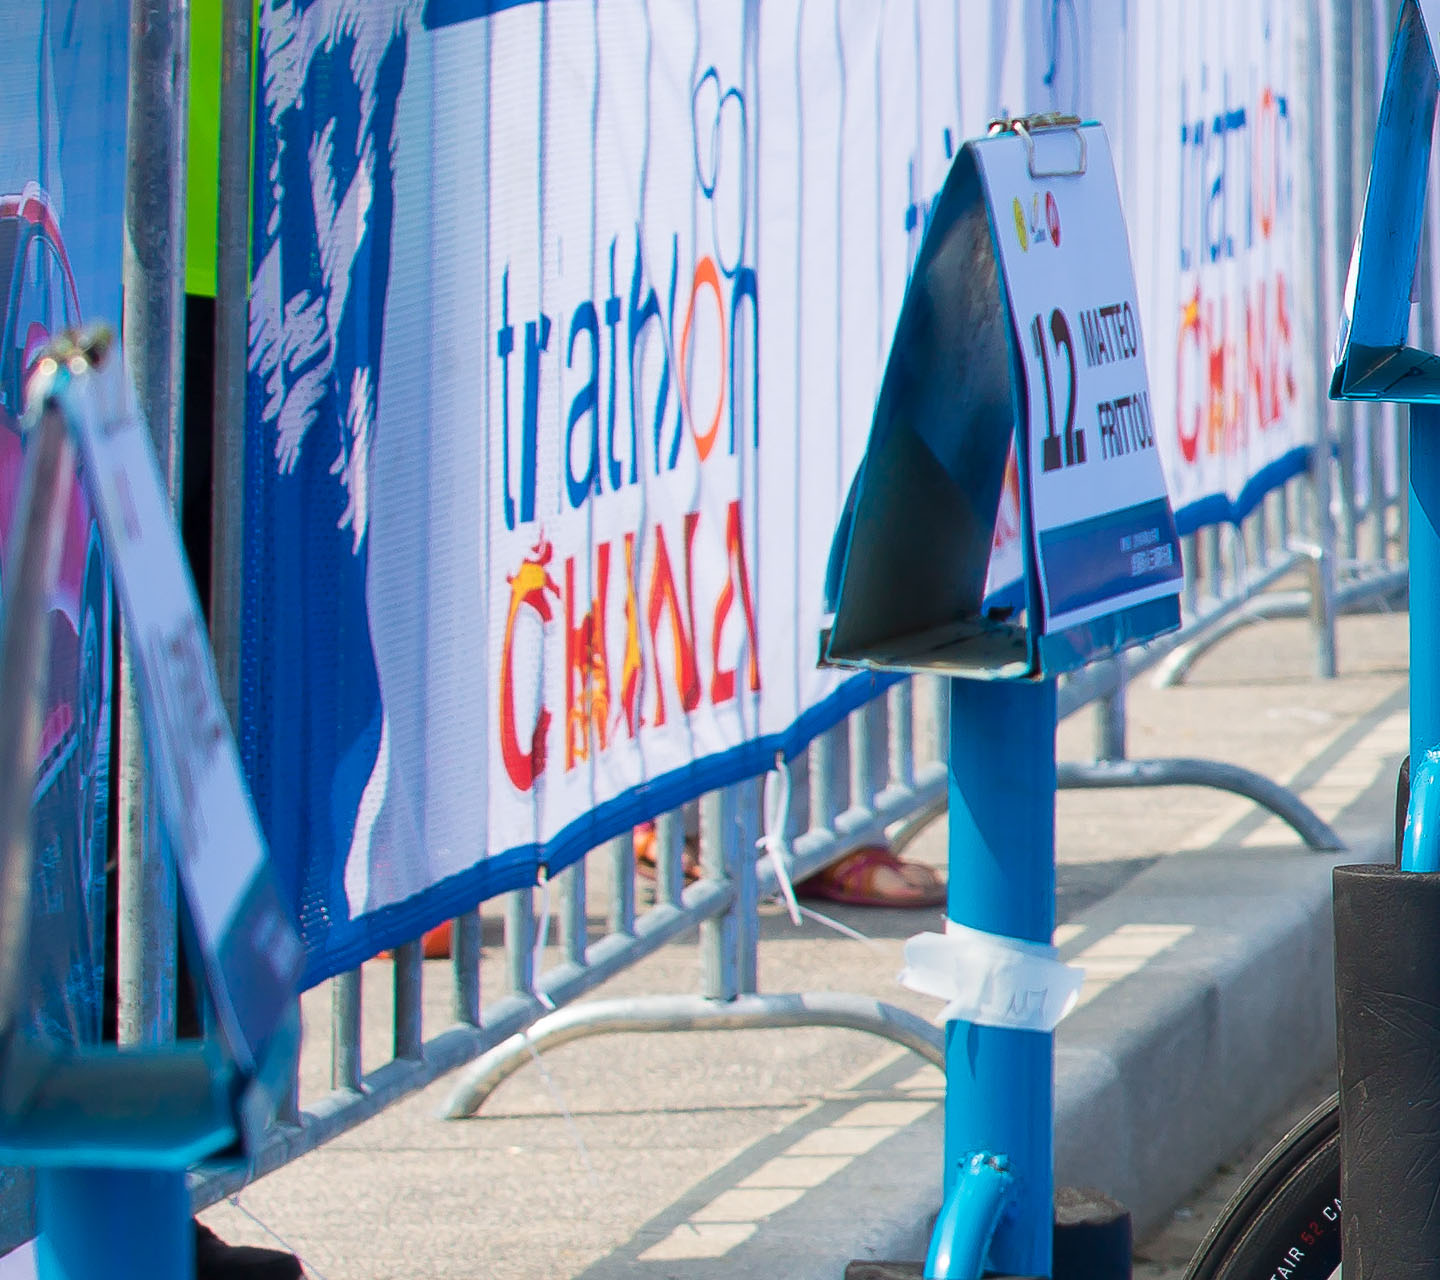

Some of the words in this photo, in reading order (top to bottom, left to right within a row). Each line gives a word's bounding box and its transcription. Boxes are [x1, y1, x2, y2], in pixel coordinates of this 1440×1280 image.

[1031, 308, 1087, 472] 12
[1079, 301, 1138, 368] MATTEO
[500, 502, 762, 791] CHINA
[1301, 1222, 1324, 1245] 52
